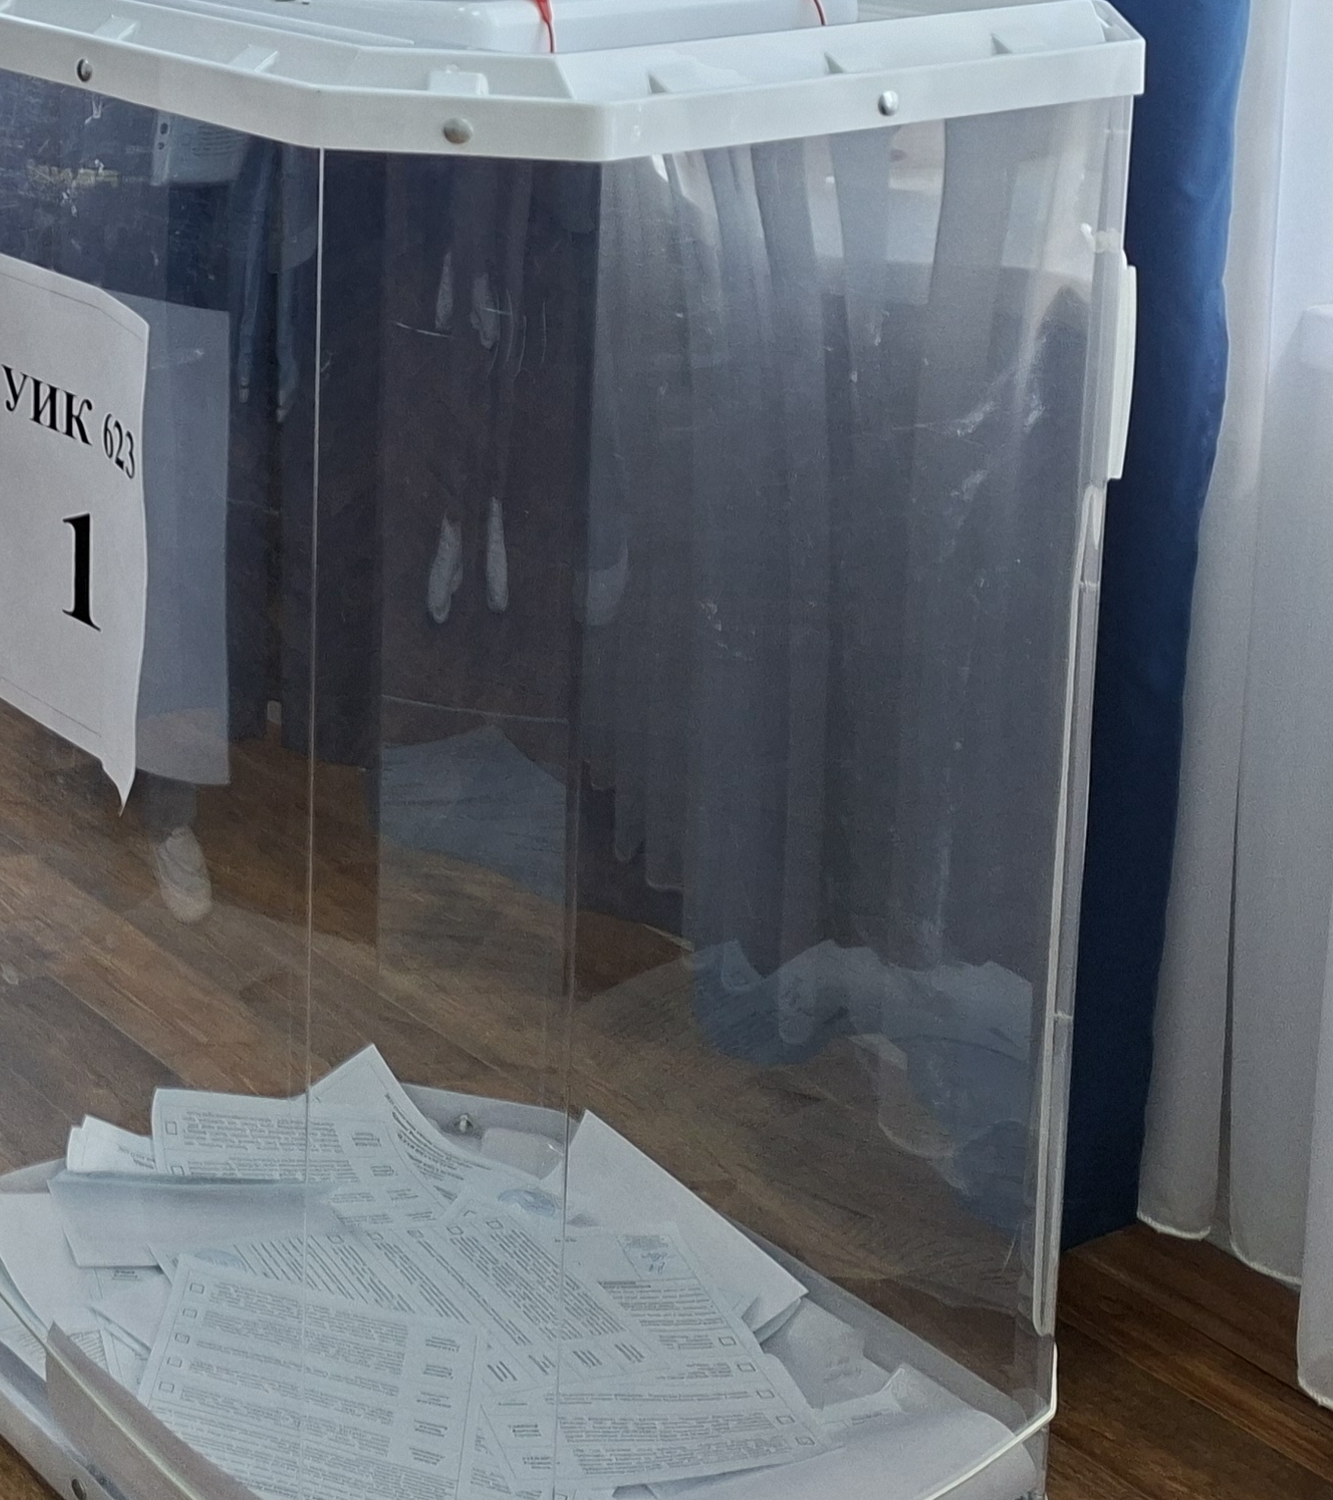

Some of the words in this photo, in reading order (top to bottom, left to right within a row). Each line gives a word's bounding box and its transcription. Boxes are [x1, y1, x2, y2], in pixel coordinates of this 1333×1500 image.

[1, 362, 93, 446] УИК
[102, 413, 136, 480] 623
[62, 513, 102, 632] 1
